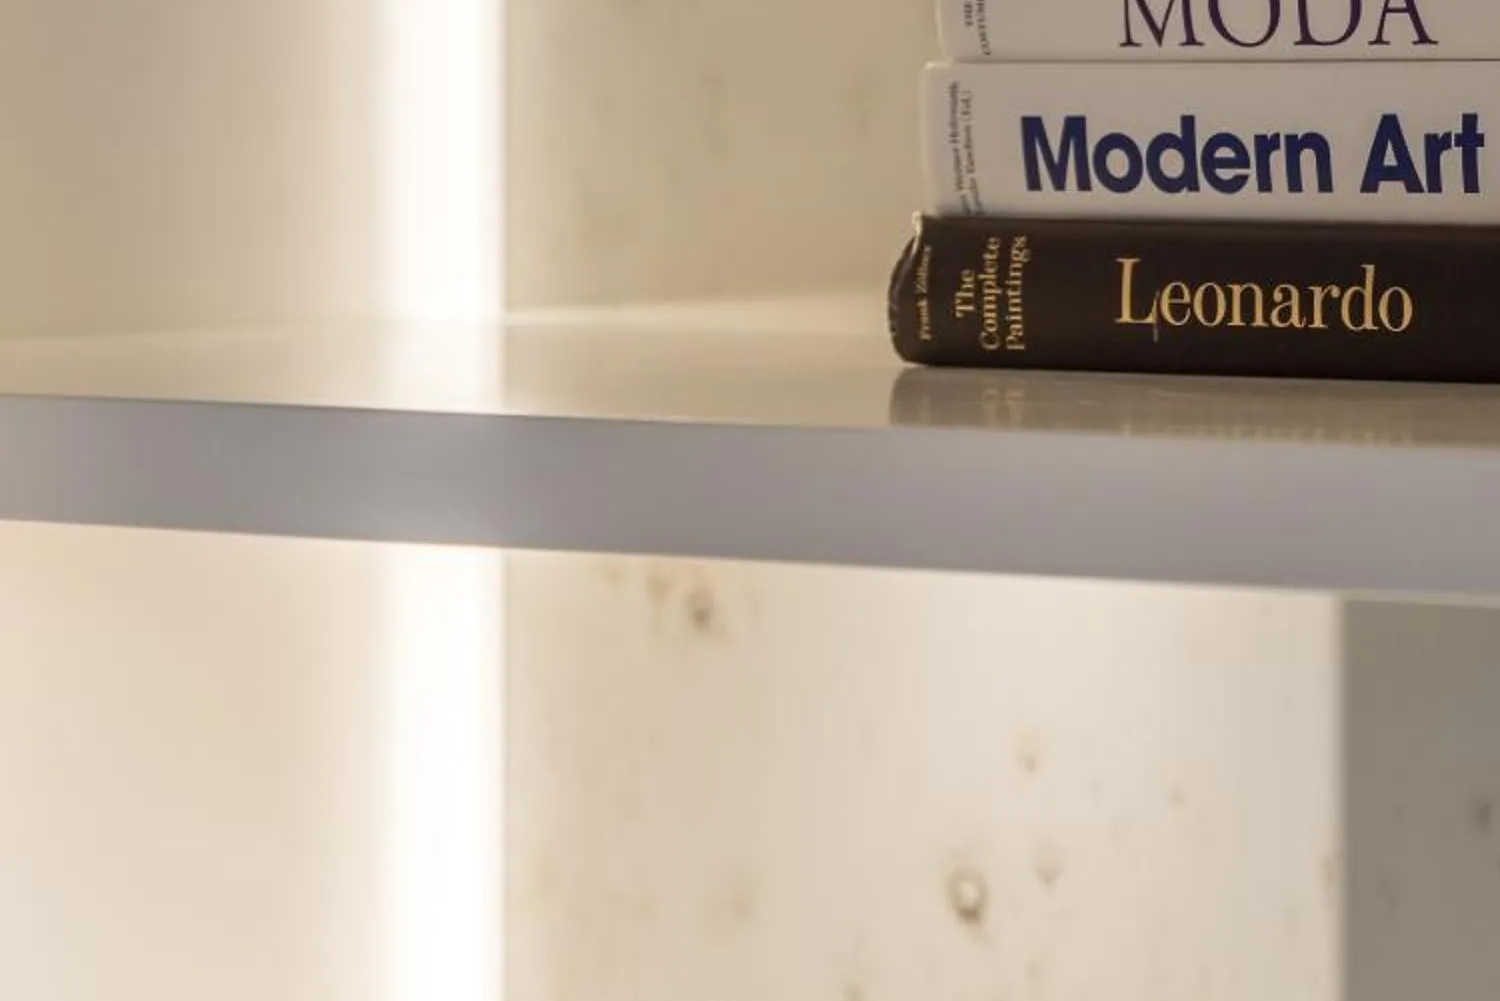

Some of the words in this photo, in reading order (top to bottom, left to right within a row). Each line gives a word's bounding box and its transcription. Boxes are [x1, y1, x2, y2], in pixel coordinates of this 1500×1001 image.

[1020, 114, 1333, 196] Modern
[1359, 112, 1486, 195] Art
[916, 298, 933, 340] Frank
[954, 268, 976, 318] The
[977, 236, 1003, 351] Complete
[1004, 235, 1032, 350] Paintings
[1114, 256, 1414, 333] Leonardo
